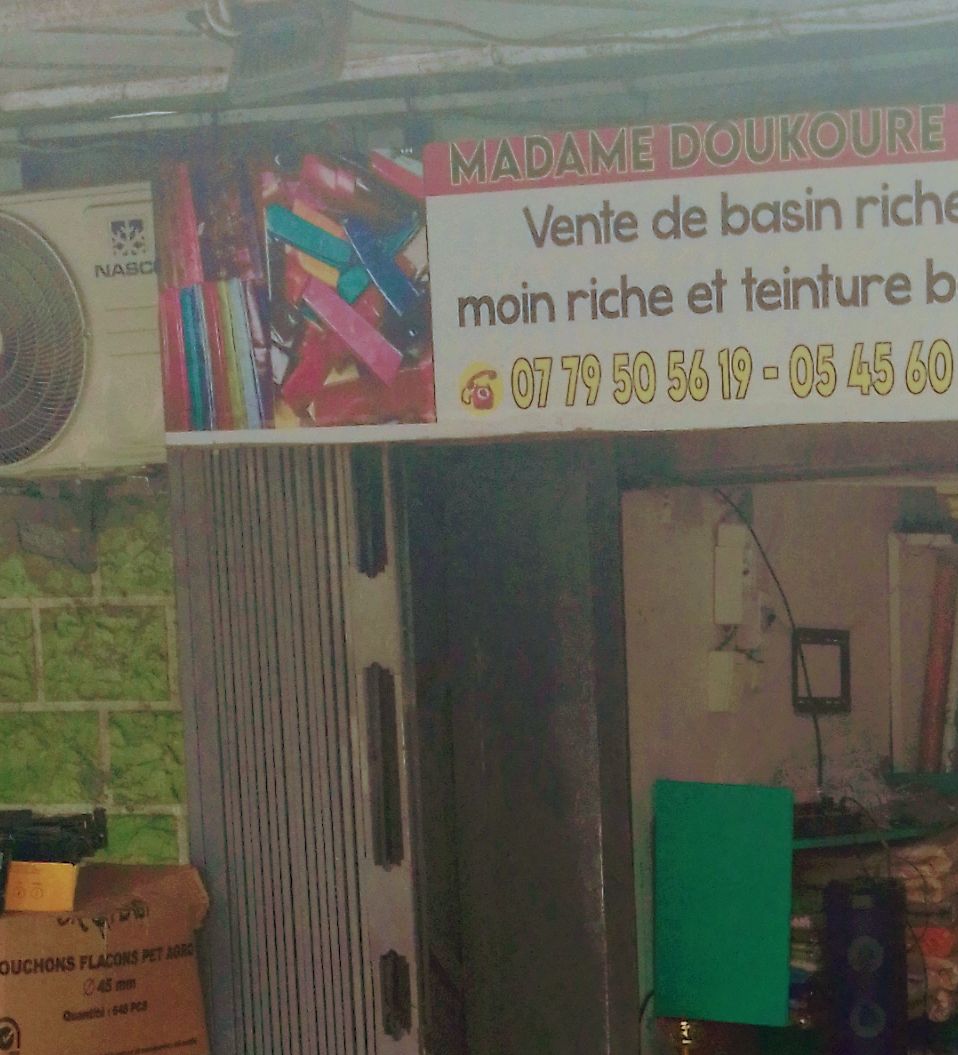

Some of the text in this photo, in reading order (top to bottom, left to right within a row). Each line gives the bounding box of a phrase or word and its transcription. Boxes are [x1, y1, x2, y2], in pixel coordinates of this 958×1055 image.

[450, 125, 655, 186] MADAME
[670, 104, 945, 169] DOUKOURE
[523, 200, 639, 248] Vente
[651, 195, 706, 240] de
[719, 186, 842, 236] basin
[458, 280, 555, 327] moin
[566, 270, 673, 322] riche
[687, 267, 727, 315] et
[741, 263, 912, 311] teinture
[510, 356, 552, 409] 07
[561, 353, 601, 406] 79
[611, 350, 657, 404] 50
[667, 348, 709, 403] 56
[717, 345, 751, 399] 19
[788, 343, 837, 397] 05
[847, 341, 894, 395] 45
[904, 338, 954, 393] 60
[80, 950, 138, 969] FLACONS
[142, 947, 162, 963] PET
[97, 978, 113, 994] 45
[115, 978, 137, 992] mm
